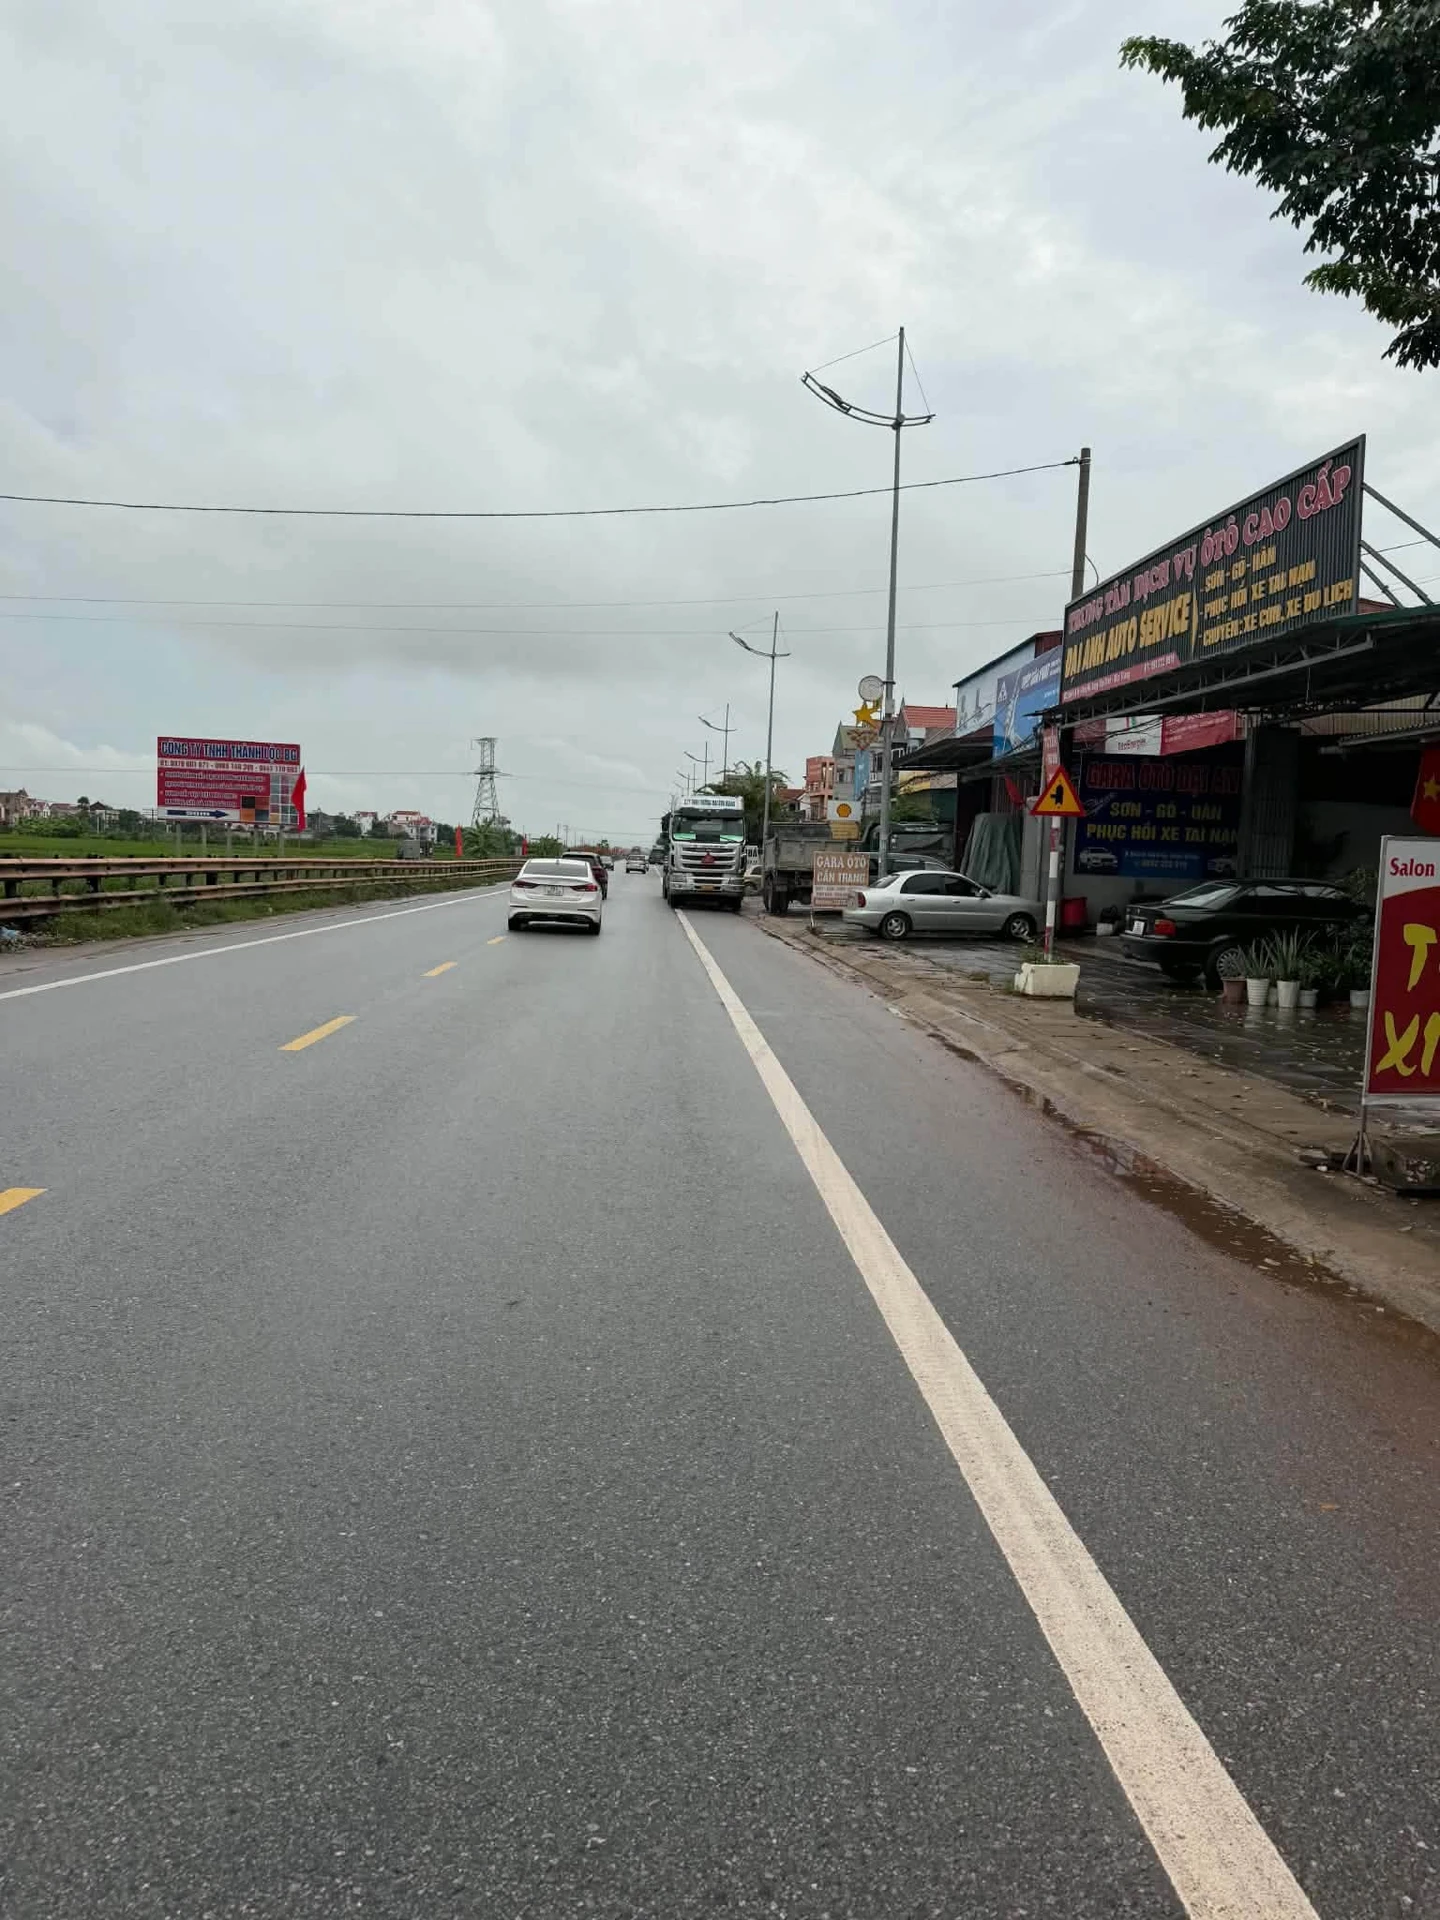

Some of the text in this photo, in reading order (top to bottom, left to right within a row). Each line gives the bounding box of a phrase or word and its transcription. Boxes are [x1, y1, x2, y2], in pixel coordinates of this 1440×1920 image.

[1133, 560, 1170, 604] DỊCH
[1173, 544, 1198, 582] VỤ
[1201, 515, 1239, 567] ÔTÔ
[1243, 497, 1291, 546] CAO
[1297, 459, 1352, 520] CẤP
[1204, 595, 1229, 621] PHỤC
[1251, 580, 1267, 602] XE
[1288, 558, 1316, 588] NẠN
[1205, 569, 1225, 593] SƠN
[1285, 597, 1303, 620] XE
[1303, 589, 1322, 614] DU
[1323, 578, 1353, 610] LỊCH
[1082, 630, 1106, 672] ANH
[1105, 616, 1138, 662] AUTO
[1139, 592, 1192, 648] SERVICE
[161, 739, 188, 756] CÔNG
[189, 742, 202, 757] TY
[203, 743, 228, 758] TNHH
[1086, 761, 1135, 790] GARA
[1109, 801, 1141, 819] SƠN
[1086, 823, 1127, 842] PHỤC
[1159, 826, 1180, 841] XE
[816, 854, 867, 869] GARA ÔTÔ
[1389, 857, 1435, 877] Salon
